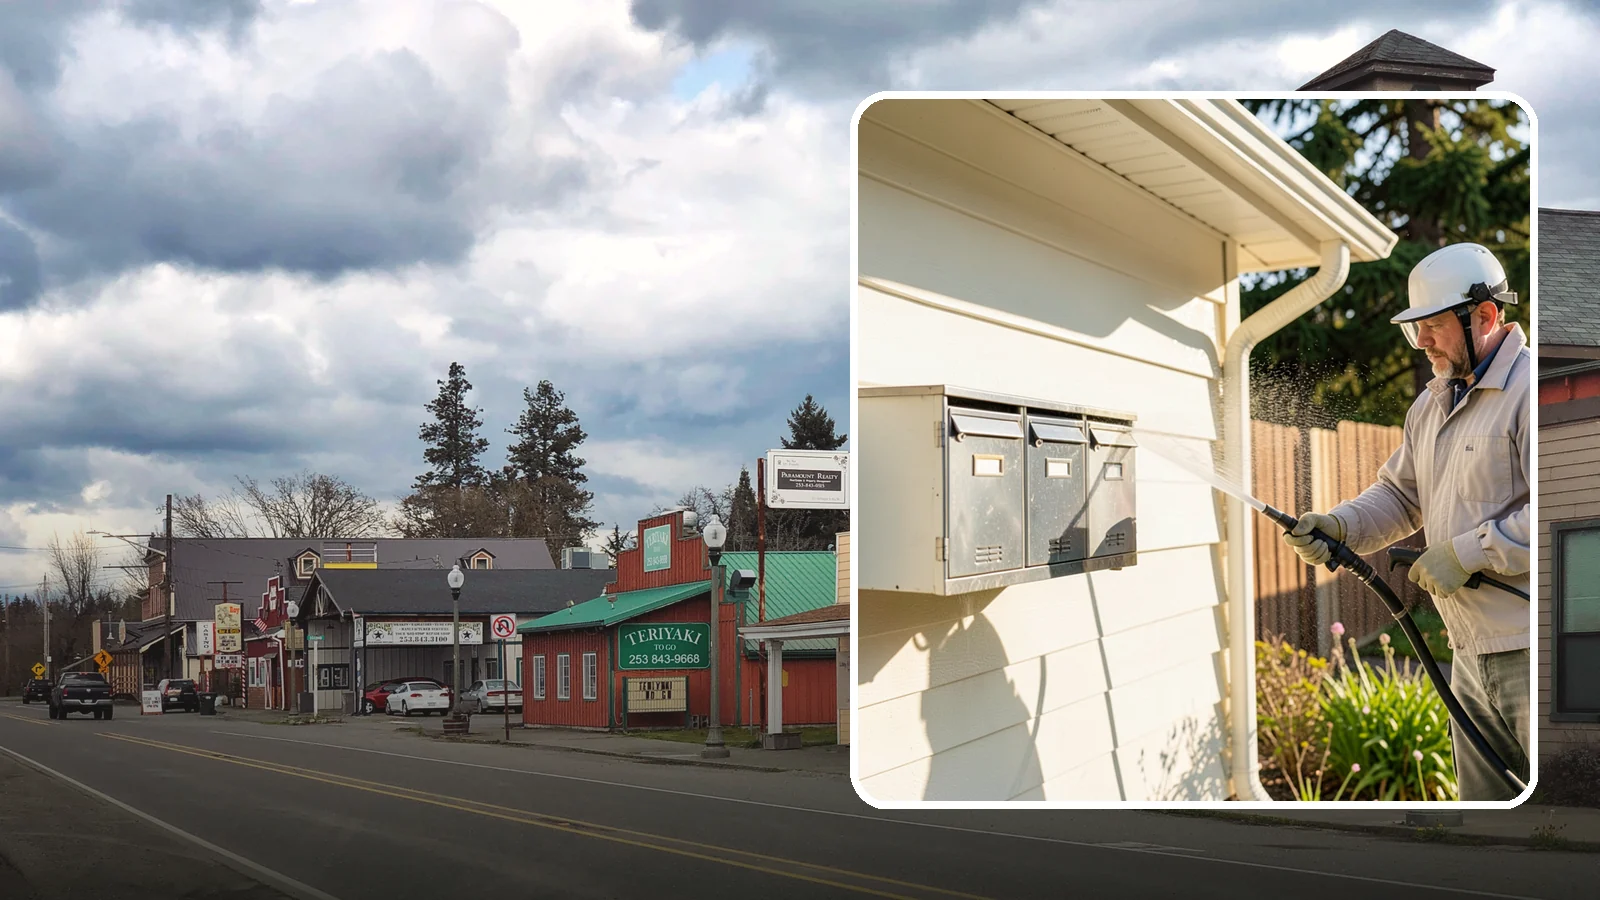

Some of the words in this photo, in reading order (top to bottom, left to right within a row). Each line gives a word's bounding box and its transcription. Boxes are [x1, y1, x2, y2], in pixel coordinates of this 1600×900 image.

[625, 627, 702, 646] TERIYAKI
[629, 654, 648, 664] 253
[652, 653, 700, 664] 843-9668
